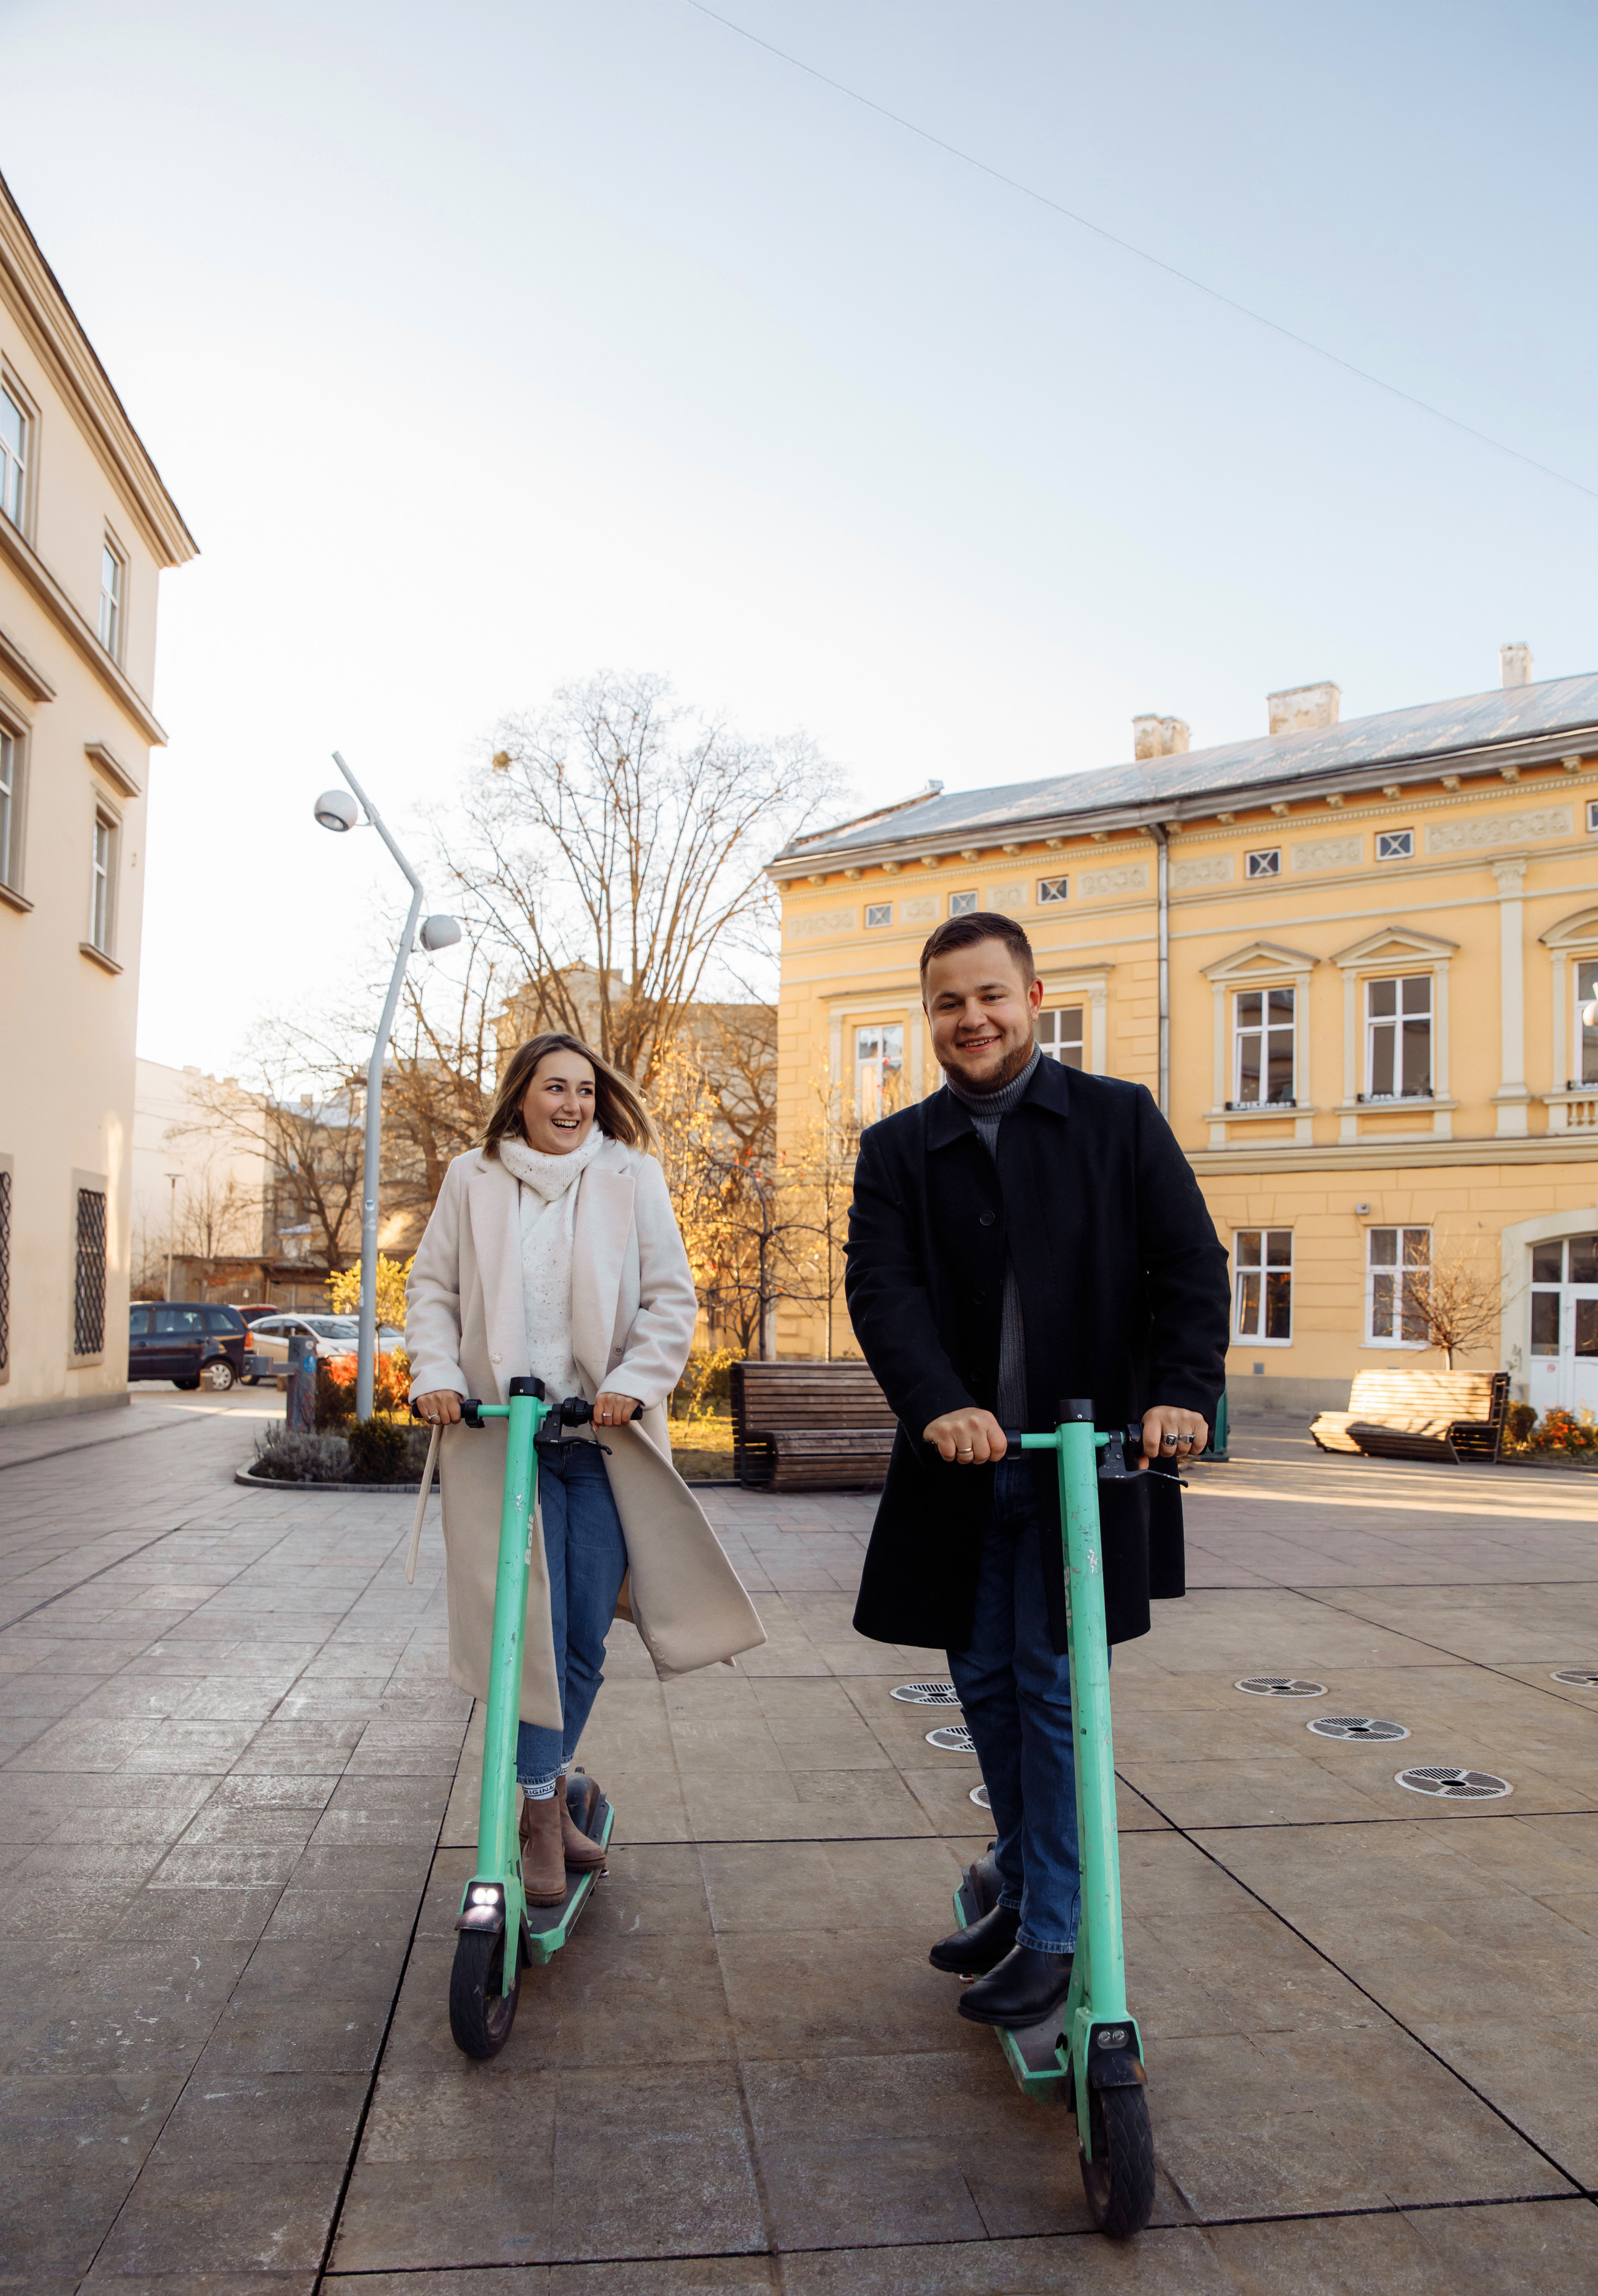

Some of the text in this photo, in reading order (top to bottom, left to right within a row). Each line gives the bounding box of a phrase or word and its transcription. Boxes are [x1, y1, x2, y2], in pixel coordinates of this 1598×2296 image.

[525, 1513, 534, 1565] Bolt
[1064, 1566, 1072, 1628] Bolt
[524, 1784, 554, 1795] RIGINA
